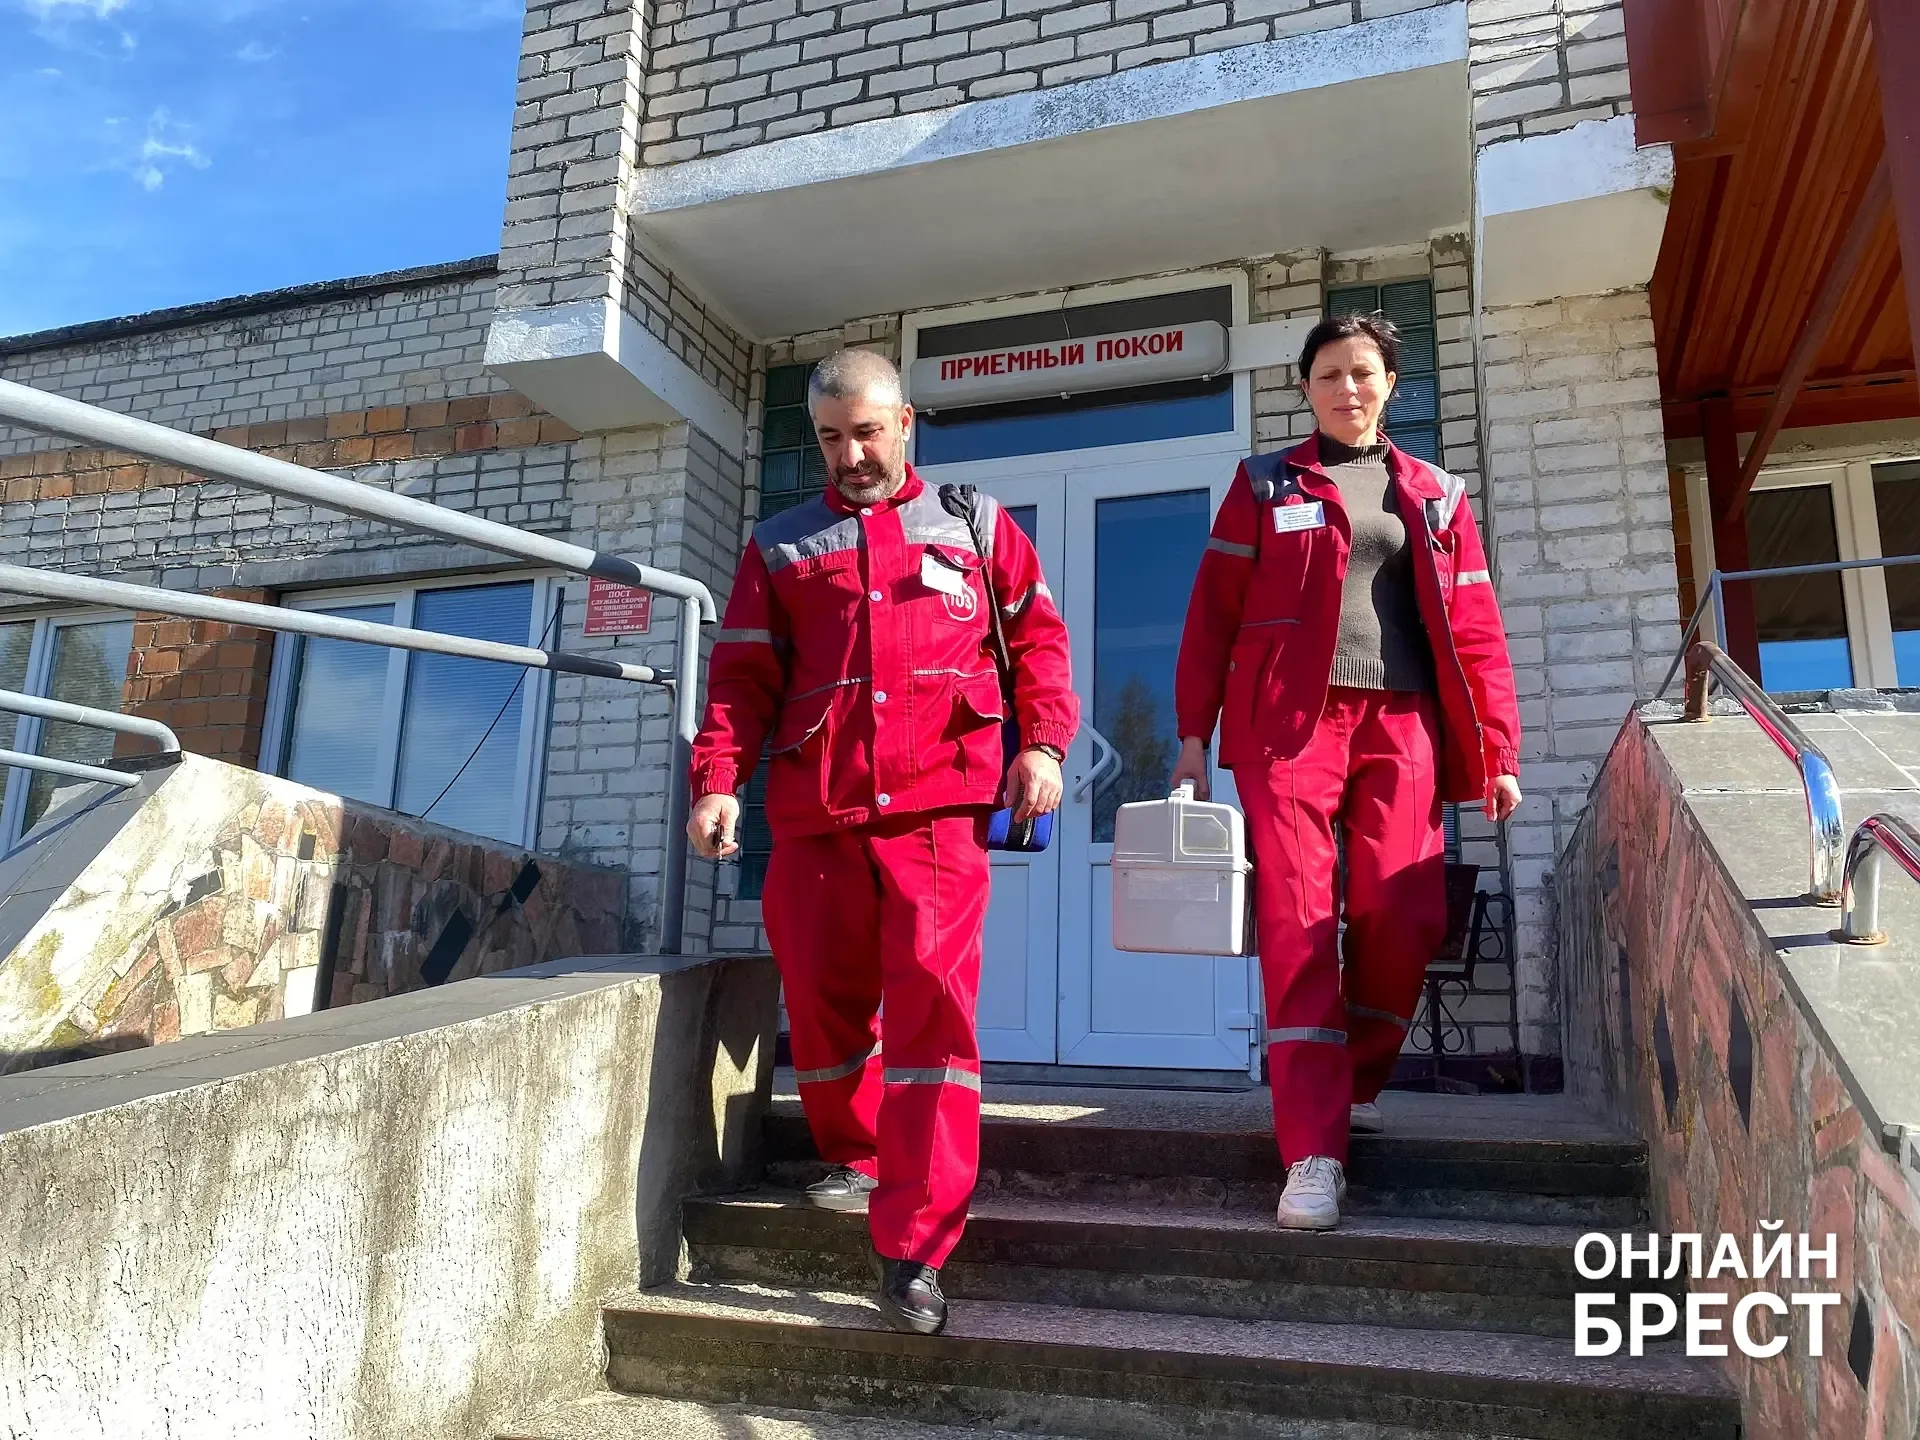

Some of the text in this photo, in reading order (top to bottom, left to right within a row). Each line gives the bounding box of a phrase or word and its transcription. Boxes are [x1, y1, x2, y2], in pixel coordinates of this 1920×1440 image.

[941, 330, 1183, 381] ПРИЕМНЫЙ ПОКОЙ
[608, 590, 631, 598] ПОСТ
[591, 596, 647, 606] СЛУЖБЫ СКОРОЙ
